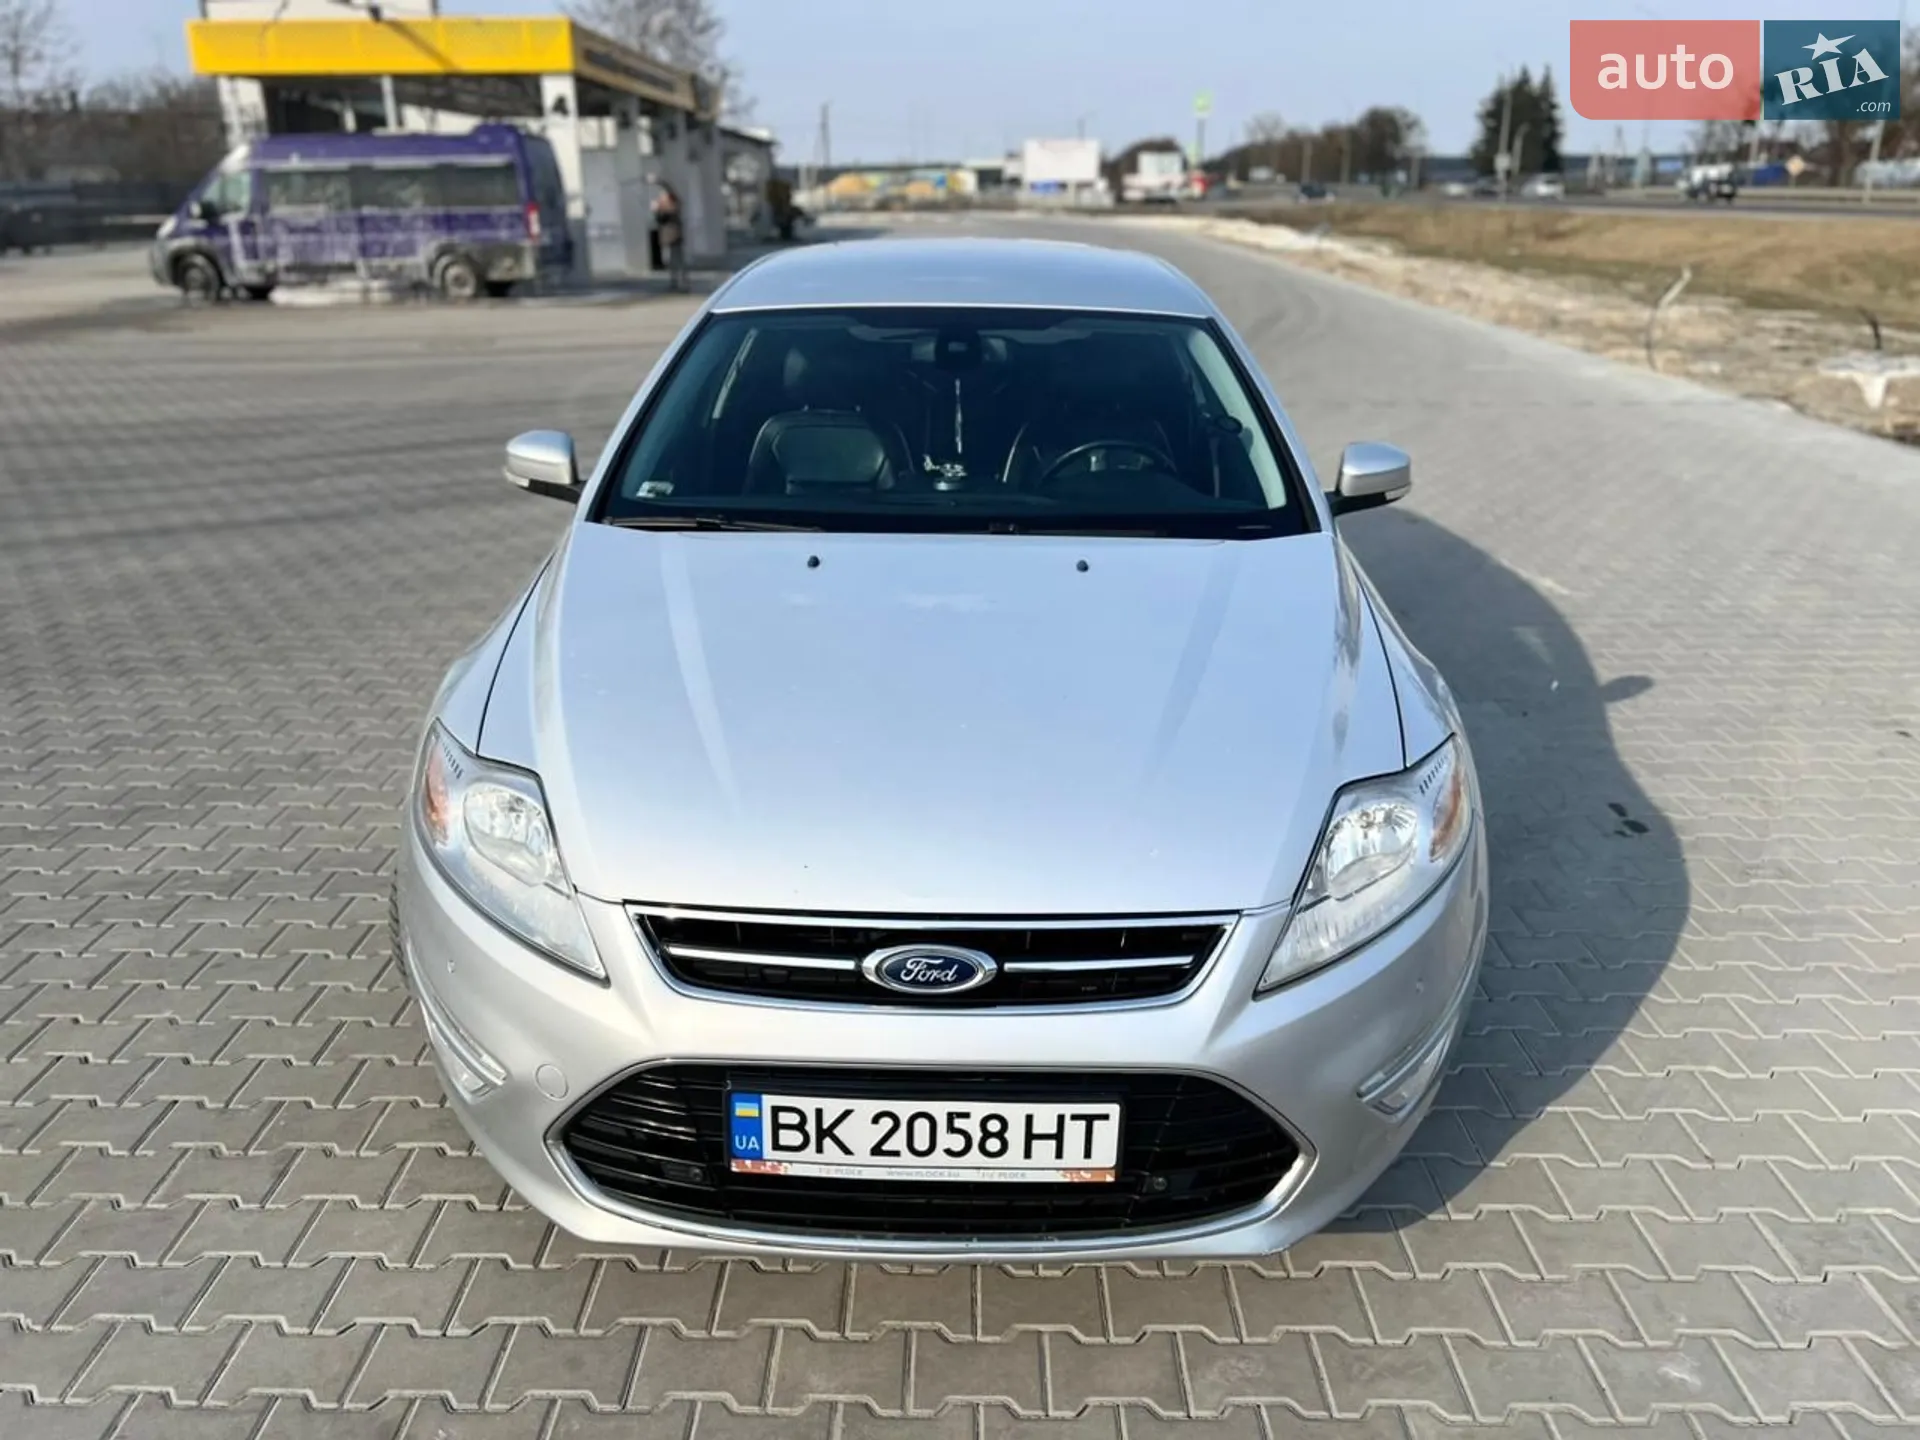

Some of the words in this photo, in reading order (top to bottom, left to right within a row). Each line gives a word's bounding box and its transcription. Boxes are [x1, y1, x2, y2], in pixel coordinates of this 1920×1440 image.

[900, 957, 958, 982] Ford
[735, 1135, 760, 1150] UA
[770, 1105, 856, 1156] BK
[869, 1110, 1010, 1159] 2058
[1023, 1113, 1111, 1160] HT
